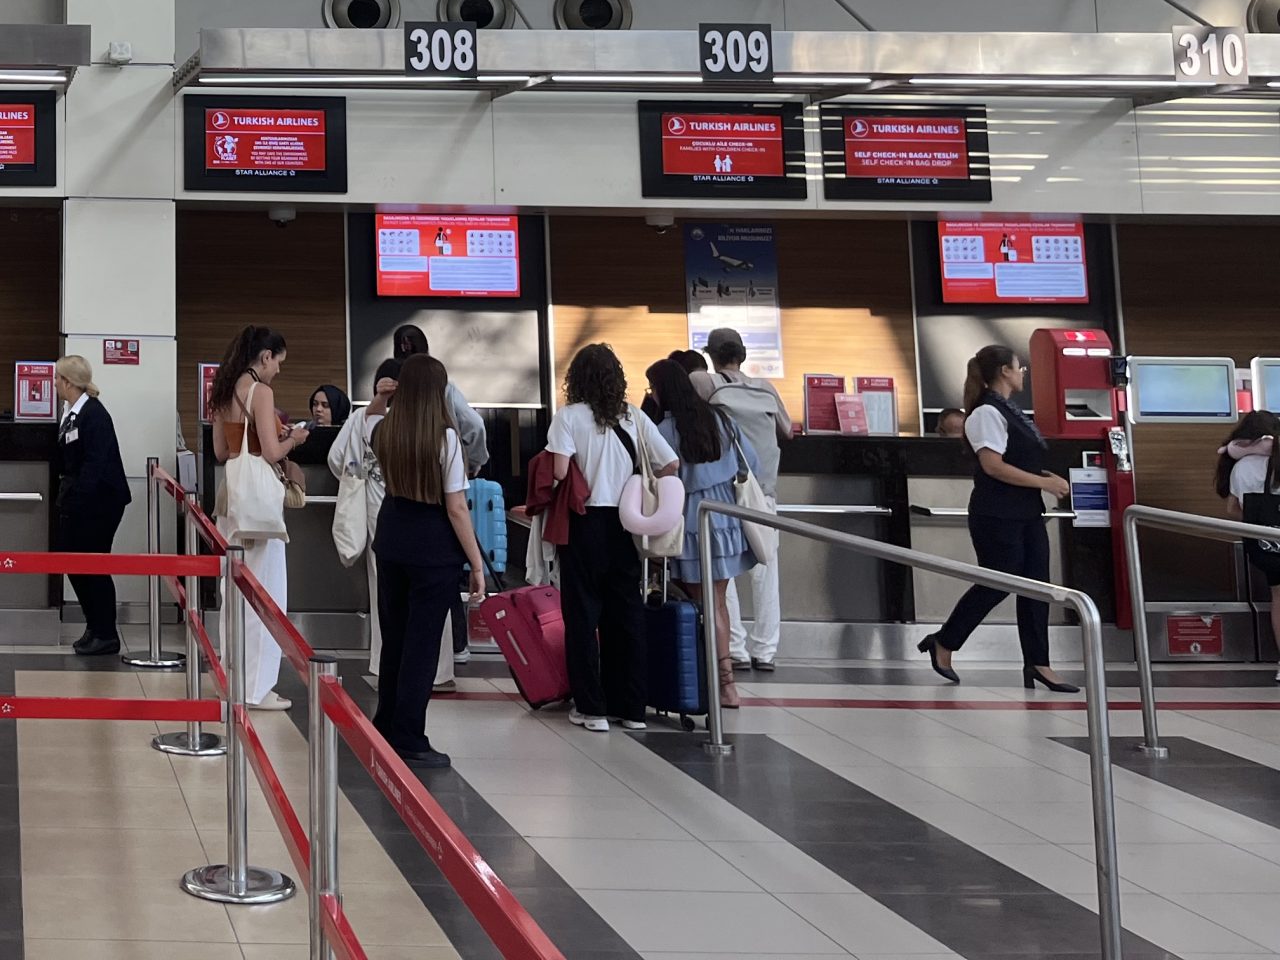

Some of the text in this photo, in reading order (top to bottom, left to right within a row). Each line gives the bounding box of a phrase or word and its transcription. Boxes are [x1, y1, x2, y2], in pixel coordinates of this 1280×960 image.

[409, 29, 474, 71] 308
[704, 30, 769, 73] 309
[1179, 33, 1244, 76] 310
[233, 116, 319, 126] TURKISH AIRLINES
[689, 121, 776, 132] TURKISH AIRLINES
[872, 124, 959, 134] TURKISH AIRLINES
